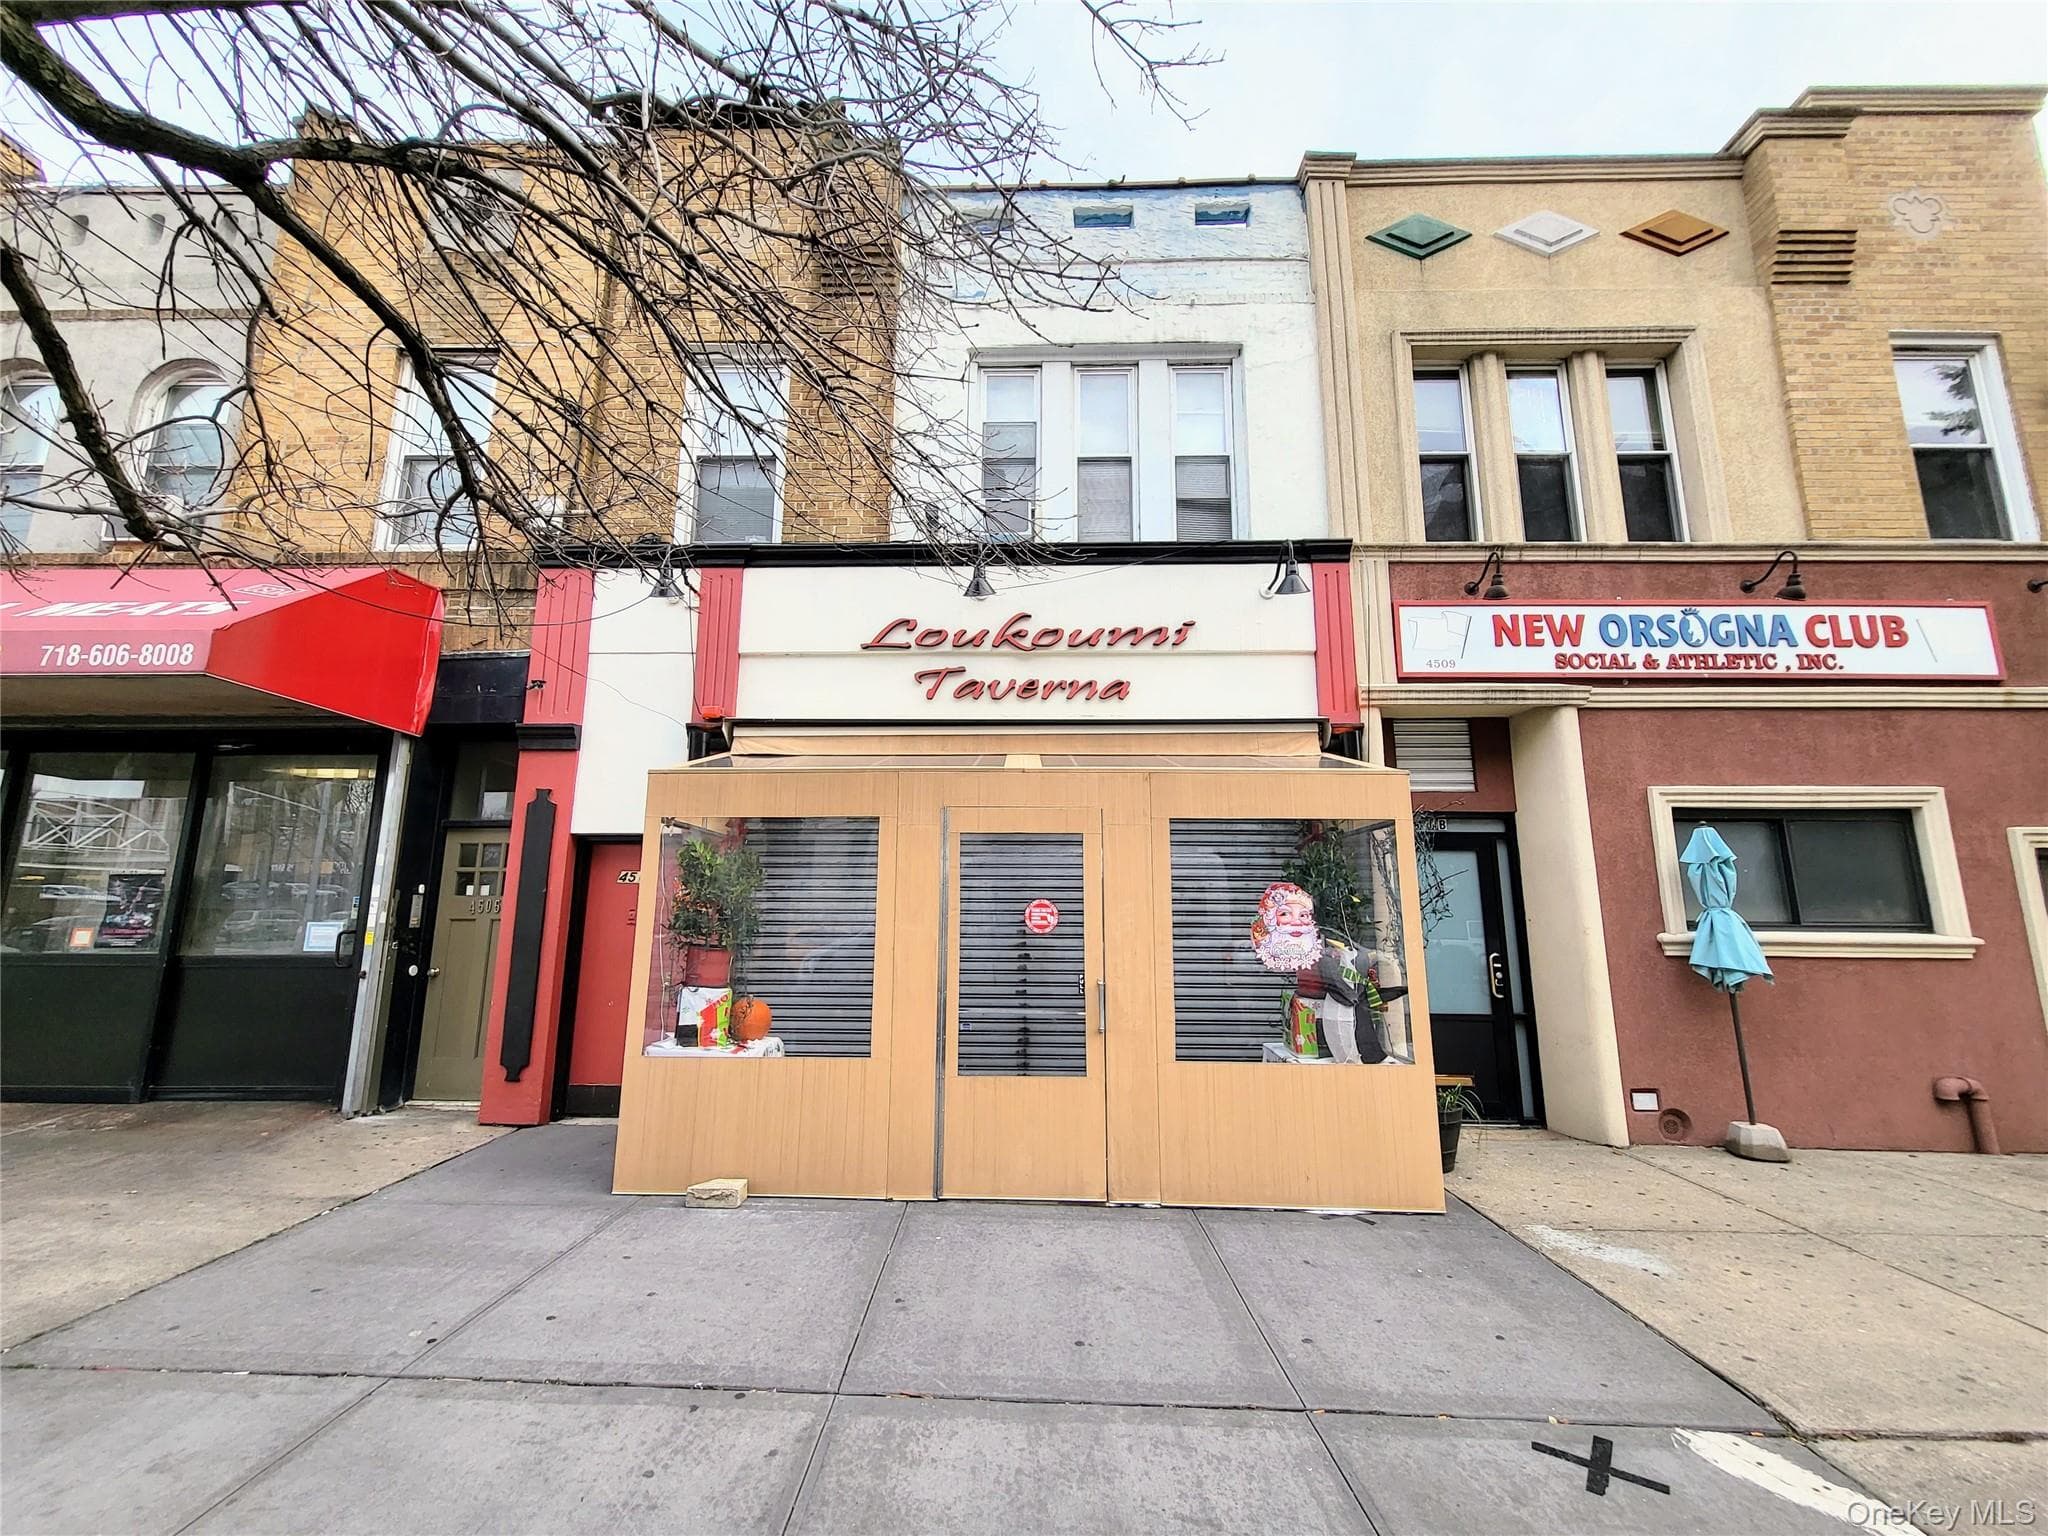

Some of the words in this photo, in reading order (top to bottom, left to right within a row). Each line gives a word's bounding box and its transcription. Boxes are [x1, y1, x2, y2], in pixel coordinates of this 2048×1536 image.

[12, 601, 251, 617] MEATS
[860, 612, 1196, 652] Loukoumi
[1491, 613, 1585, 648] NEW
[1599, 609, 1799, 648] ORSOGNA
[1804, 613, 1910, 648] CLUB
[39, 643, 195, 667] 718-606-8008
[1426, 659, 1456, 669] 4509
[1554, 653, 1637, 671] SOCIAL
[1643, 653, 1661, 670] &
[1797, 653, 1845, 671] INC.
[914, 666, 1131, 701] Taverna
[619, 872, 640, 883] 45
